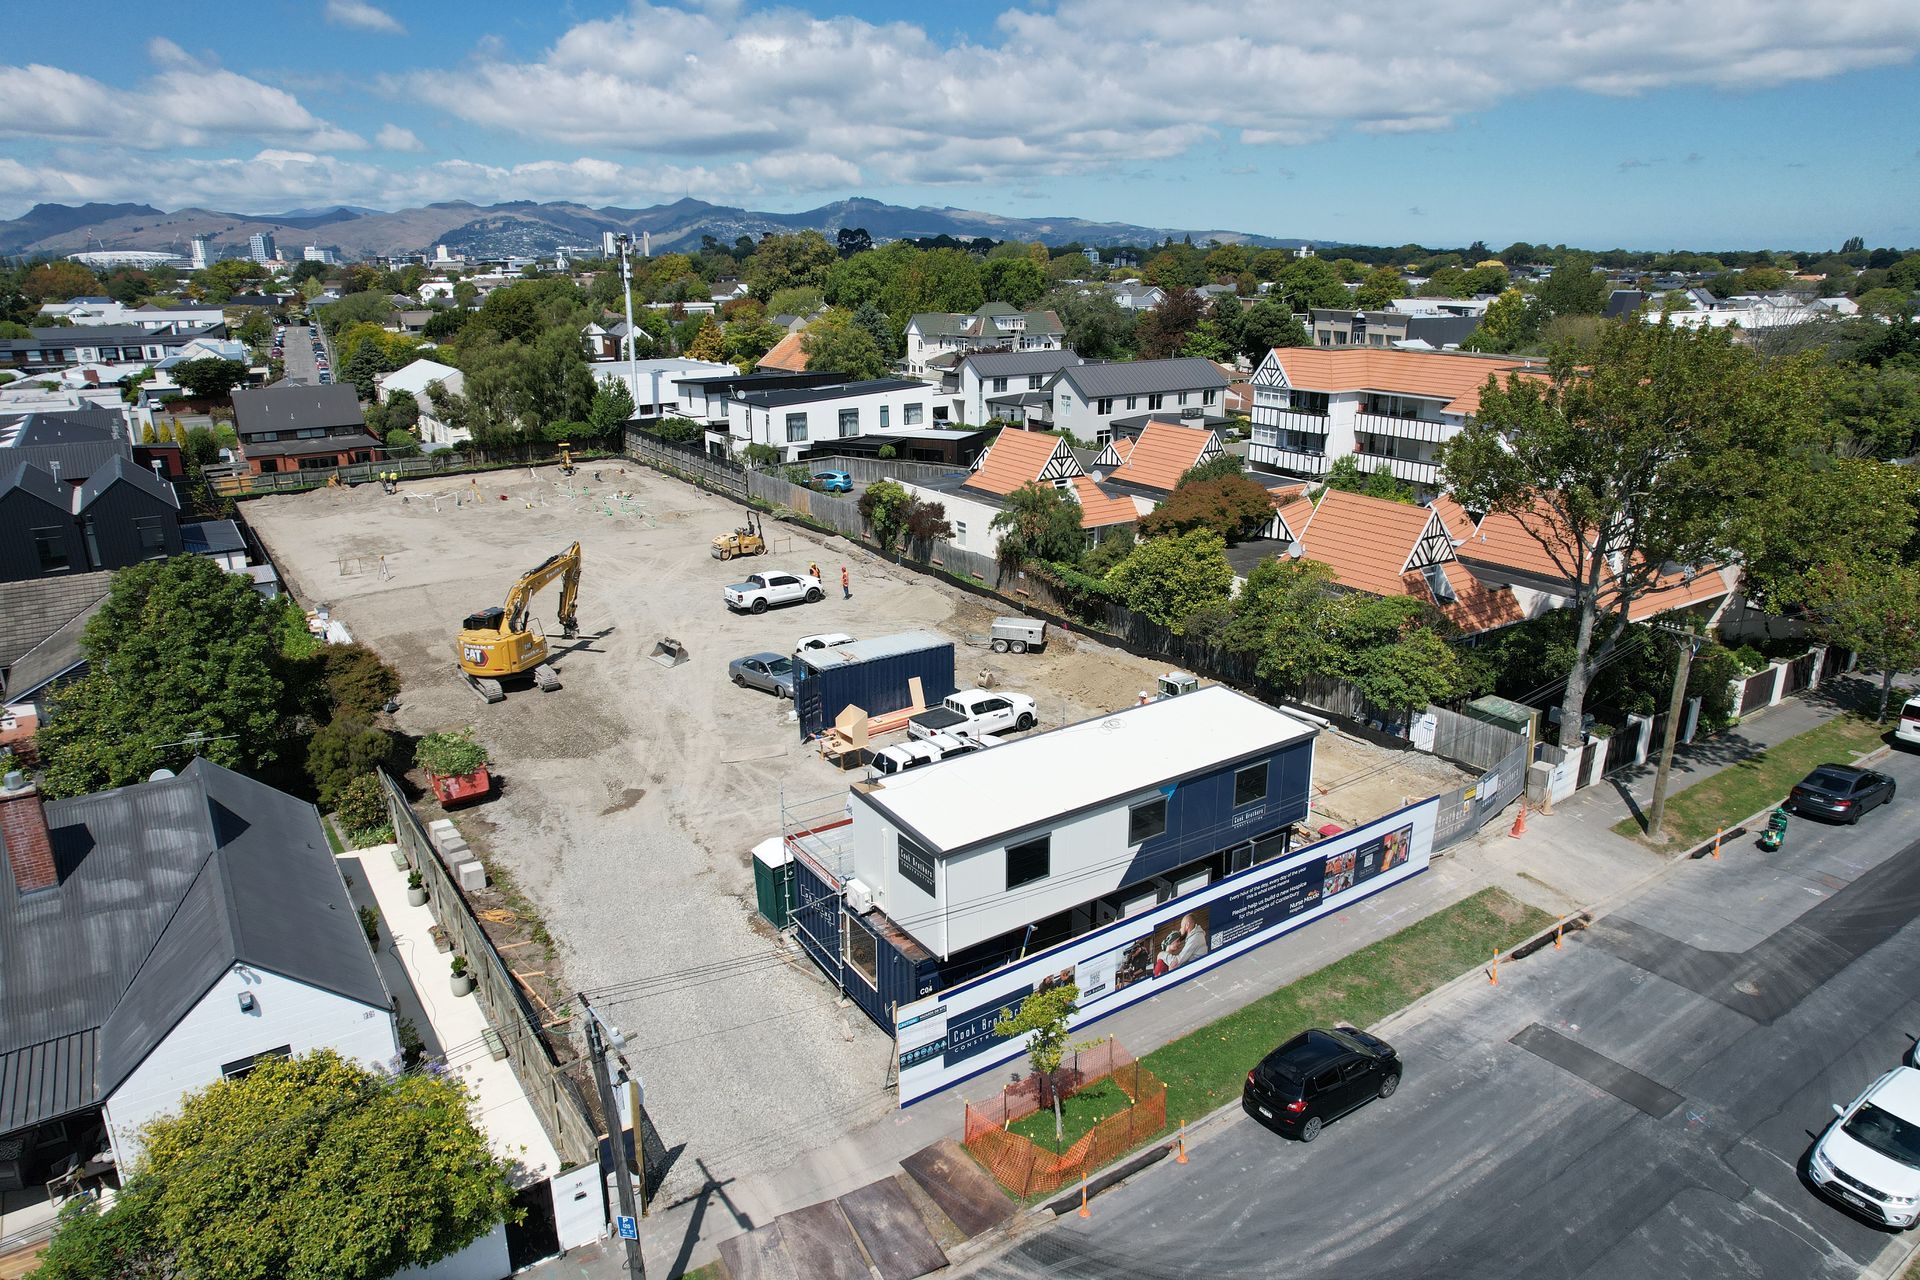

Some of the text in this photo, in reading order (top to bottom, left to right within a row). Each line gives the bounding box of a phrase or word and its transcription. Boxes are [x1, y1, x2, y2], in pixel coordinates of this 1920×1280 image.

[464, 647, 481, 663] CAT
[1245, 808, 1264, 819] Brothers
[900, 848, 933, 878] Cook Brothers
[1231, 906, 1247, 916] Please
[1248, 902, 1258, 910] help
[1264, 893, 1276, 903] build
[1290, 881, 1307, 892] Hospice
[1253, 903, 1270, 915] people
[1275, 891, 1300, 904] Canterbury
[1289, 892, 1320, 909] Nurse Maude
[920, 985, 933, 995] C04
[953, 1007, 1023, 1043] Cook Brotrs
